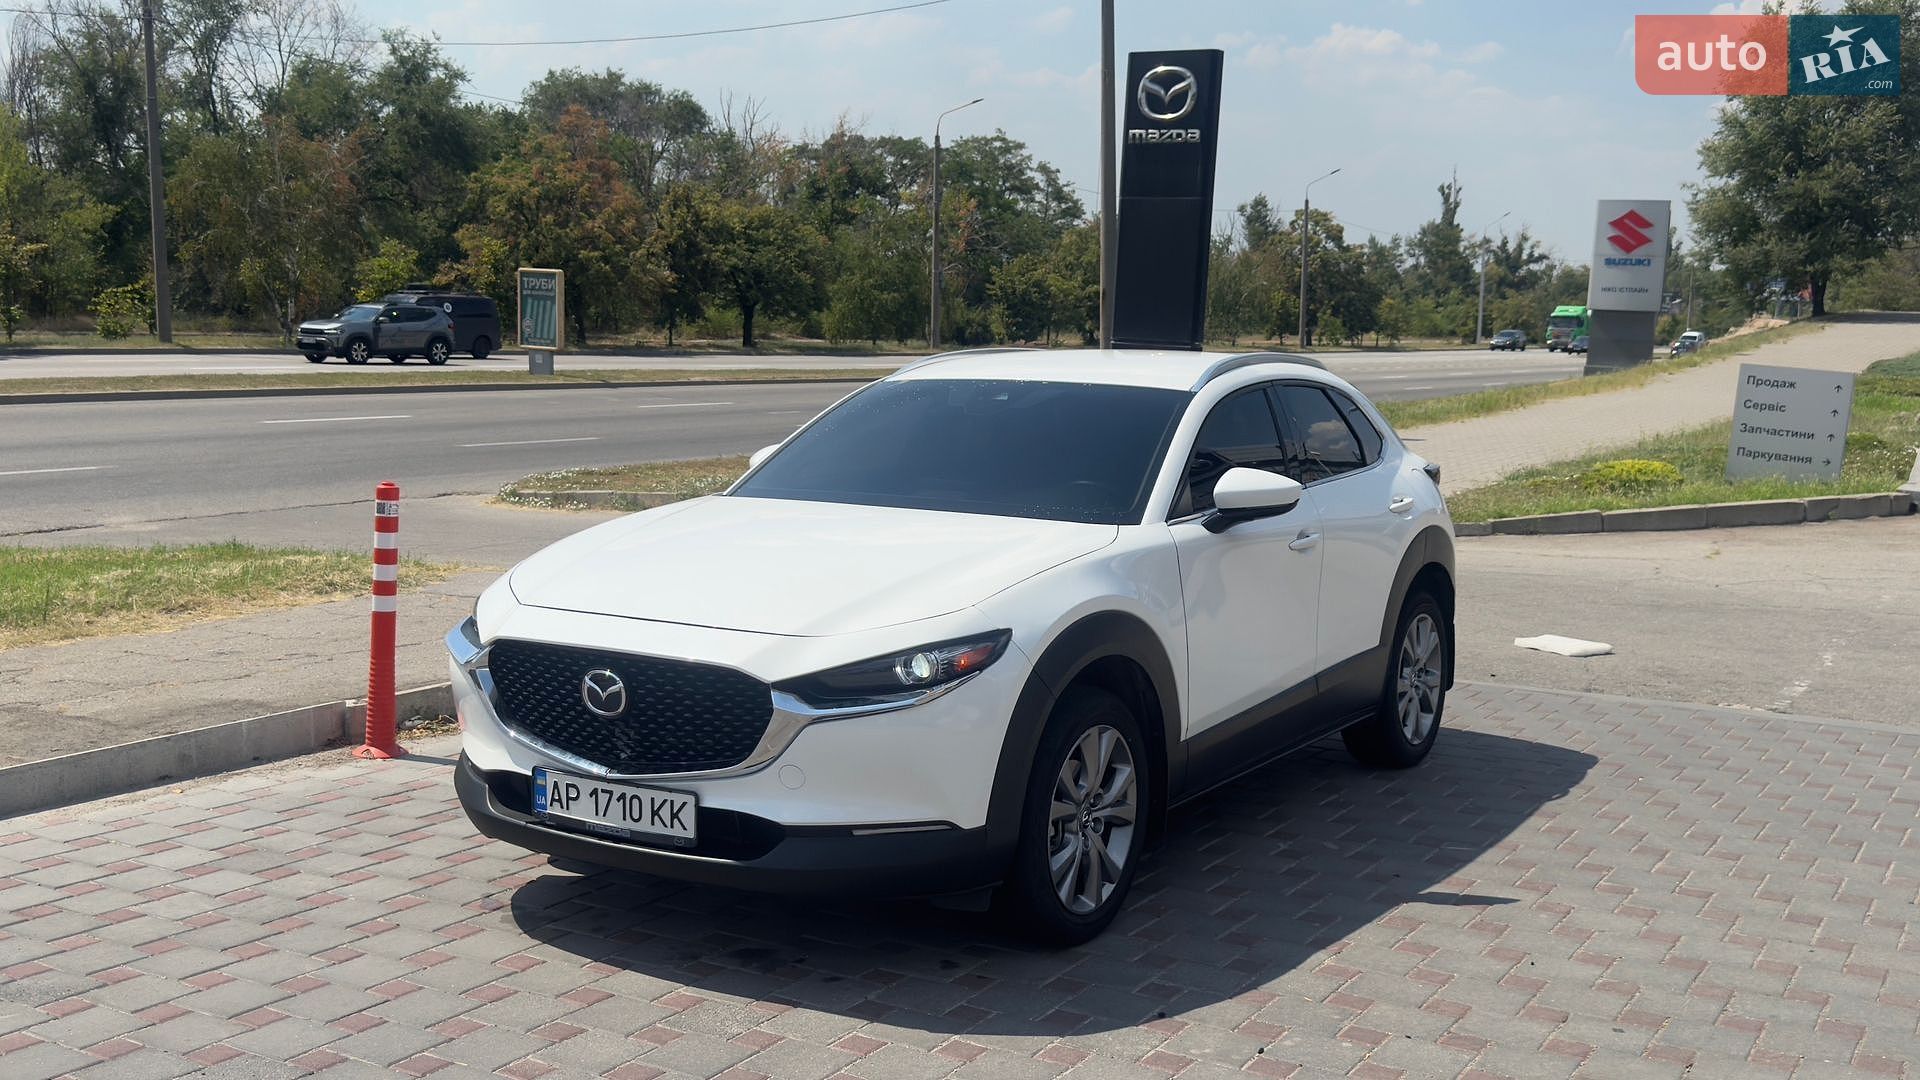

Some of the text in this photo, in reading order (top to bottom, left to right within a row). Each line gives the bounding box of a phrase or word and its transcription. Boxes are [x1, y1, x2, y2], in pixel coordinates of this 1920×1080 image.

[1604, 257, 1651, 267] SUZUKI
[522, 277, 556, 290] ТРУБИ
[1746, 375, 1797, 389] Продаж
[1743, 399, 1786, 413] Сервіс
[1739, 422, 1815, 441] Запчастини
[1736, 446, 1813, 465] Паркування
[536, 795, 546, 806] UA
[549, 780, 688, 832] AP 1710 KK
